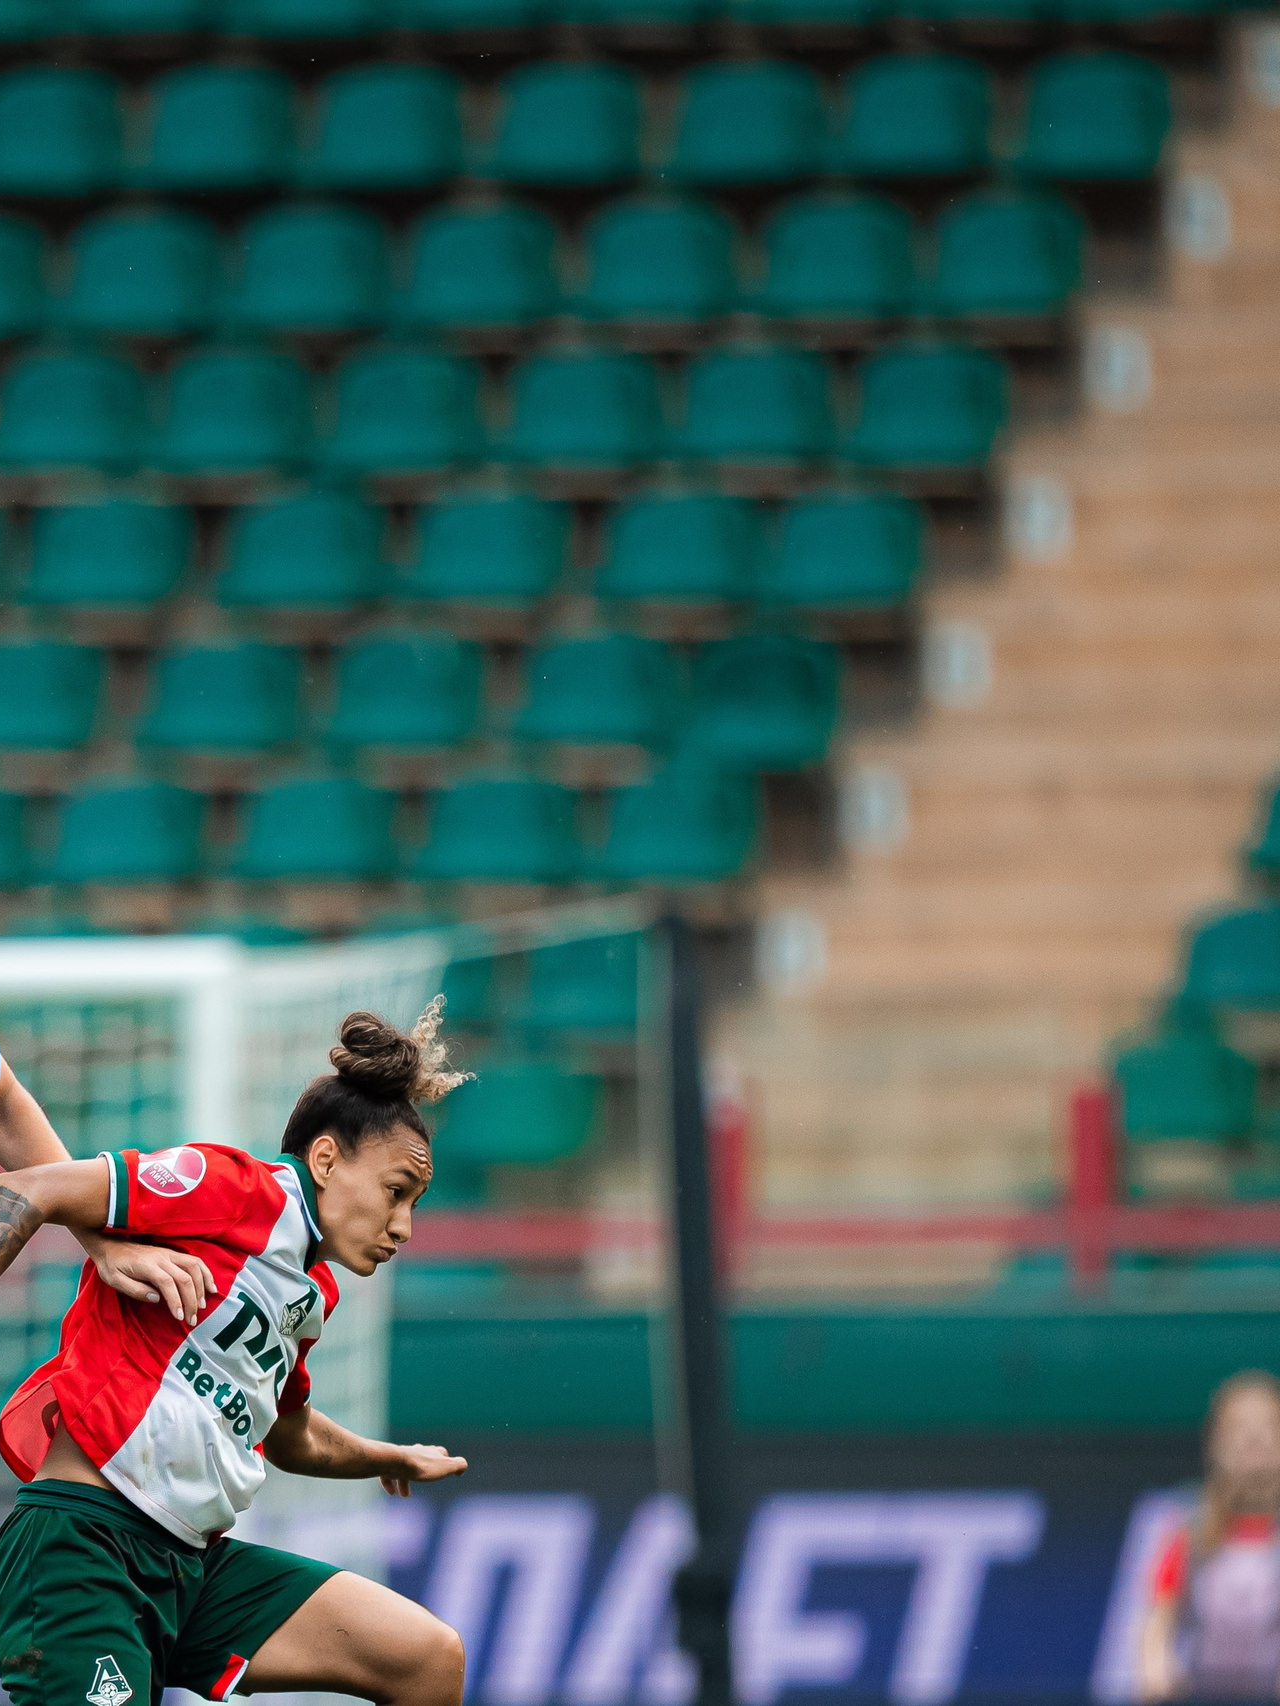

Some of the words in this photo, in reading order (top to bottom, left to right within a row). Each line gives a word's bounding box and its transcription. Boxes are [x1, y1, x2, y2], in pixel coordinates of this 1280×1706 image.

[148, 1170, 168, 1188] ЛИГА
[153, 1163, 176, 1184] СУПЕР
[175, 1347, 252, 1451] BetBo
